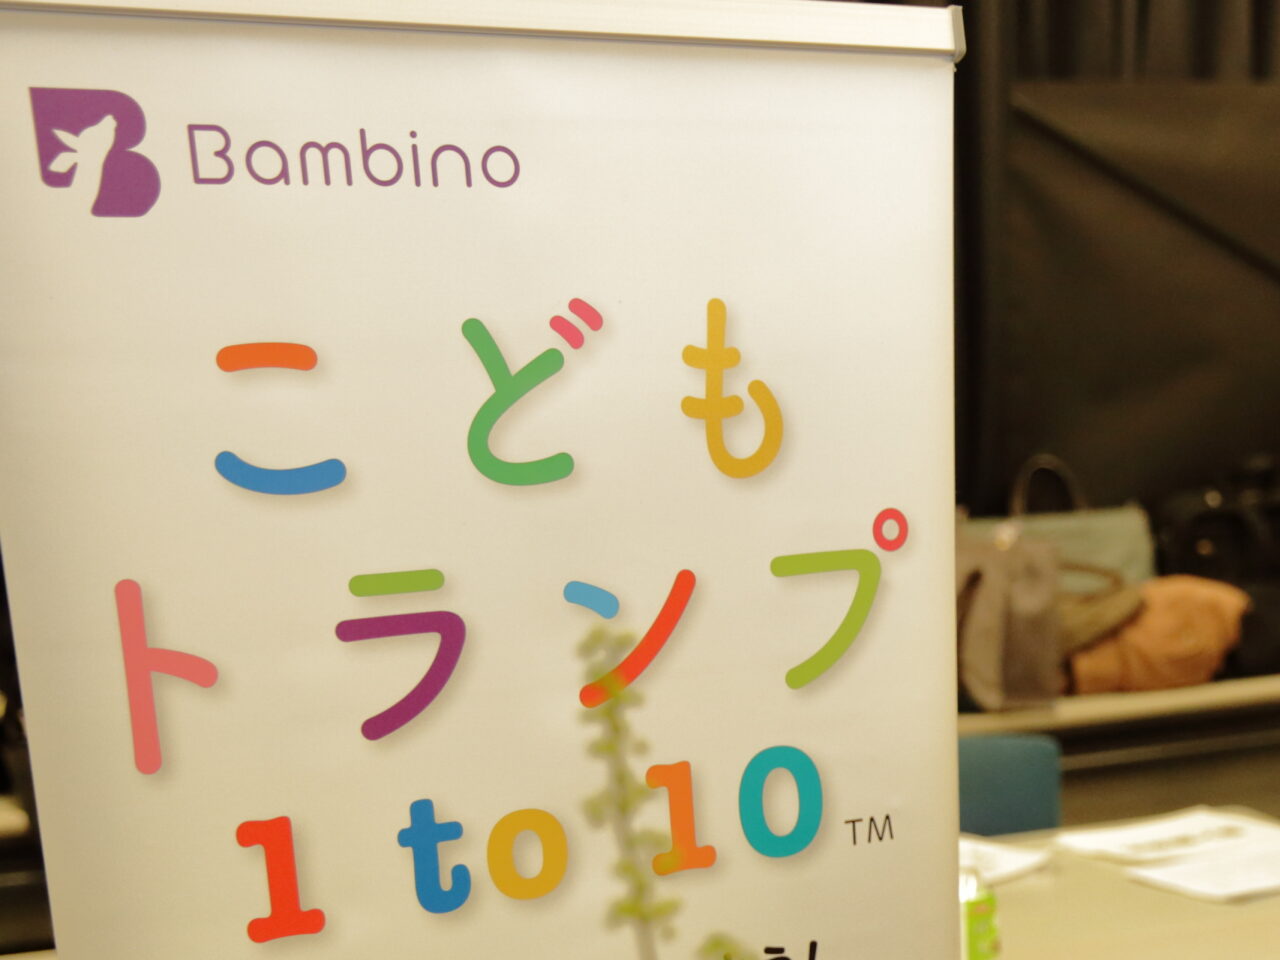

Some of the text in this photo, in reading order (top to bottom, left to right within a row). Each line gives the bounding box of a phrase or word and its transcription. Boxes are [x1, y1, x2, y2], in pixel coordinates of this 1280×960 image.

[187, 123, 521, 189] Bambino
[215, 298, 784, 496] こども
[114, 507, 909, 776] トランプ
[236, 816, 326, 944] 1
[397, 798, 569, 914] to
[645, 744, 825, 877] 10
